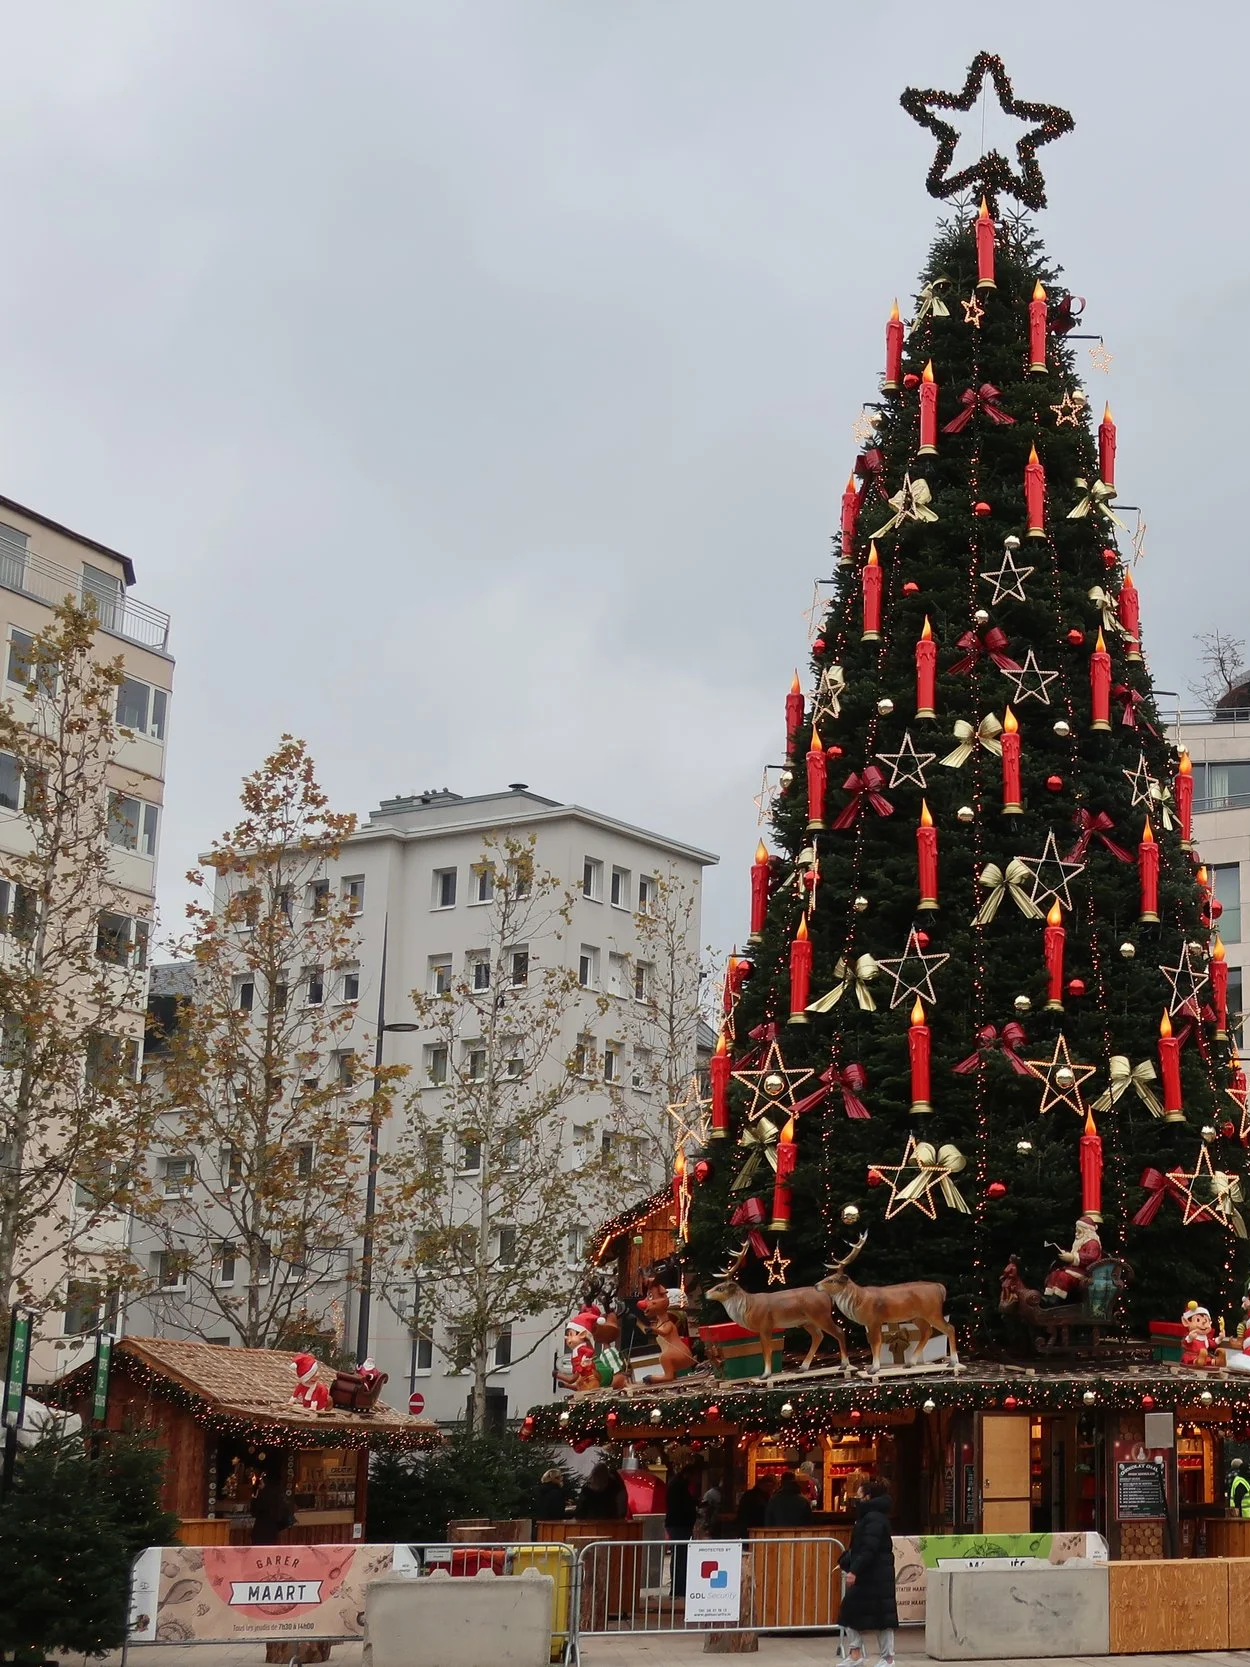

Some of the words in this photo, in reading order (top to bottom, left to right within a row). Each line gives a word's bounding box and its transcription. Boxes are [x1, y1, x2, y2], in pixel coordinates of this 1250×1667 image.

[256, 1555, 300, 1569] GARER
[248, 1584, 306, 1601] MAART
[689, 1592, 706, 1600] GDL
[707, 1592, 736, 1600] Security
[233, 1624, 245, 1632] Tous
[278, 1622, 292, 1631] 7h30
[297, 1621, 315, 1630] 14h00
